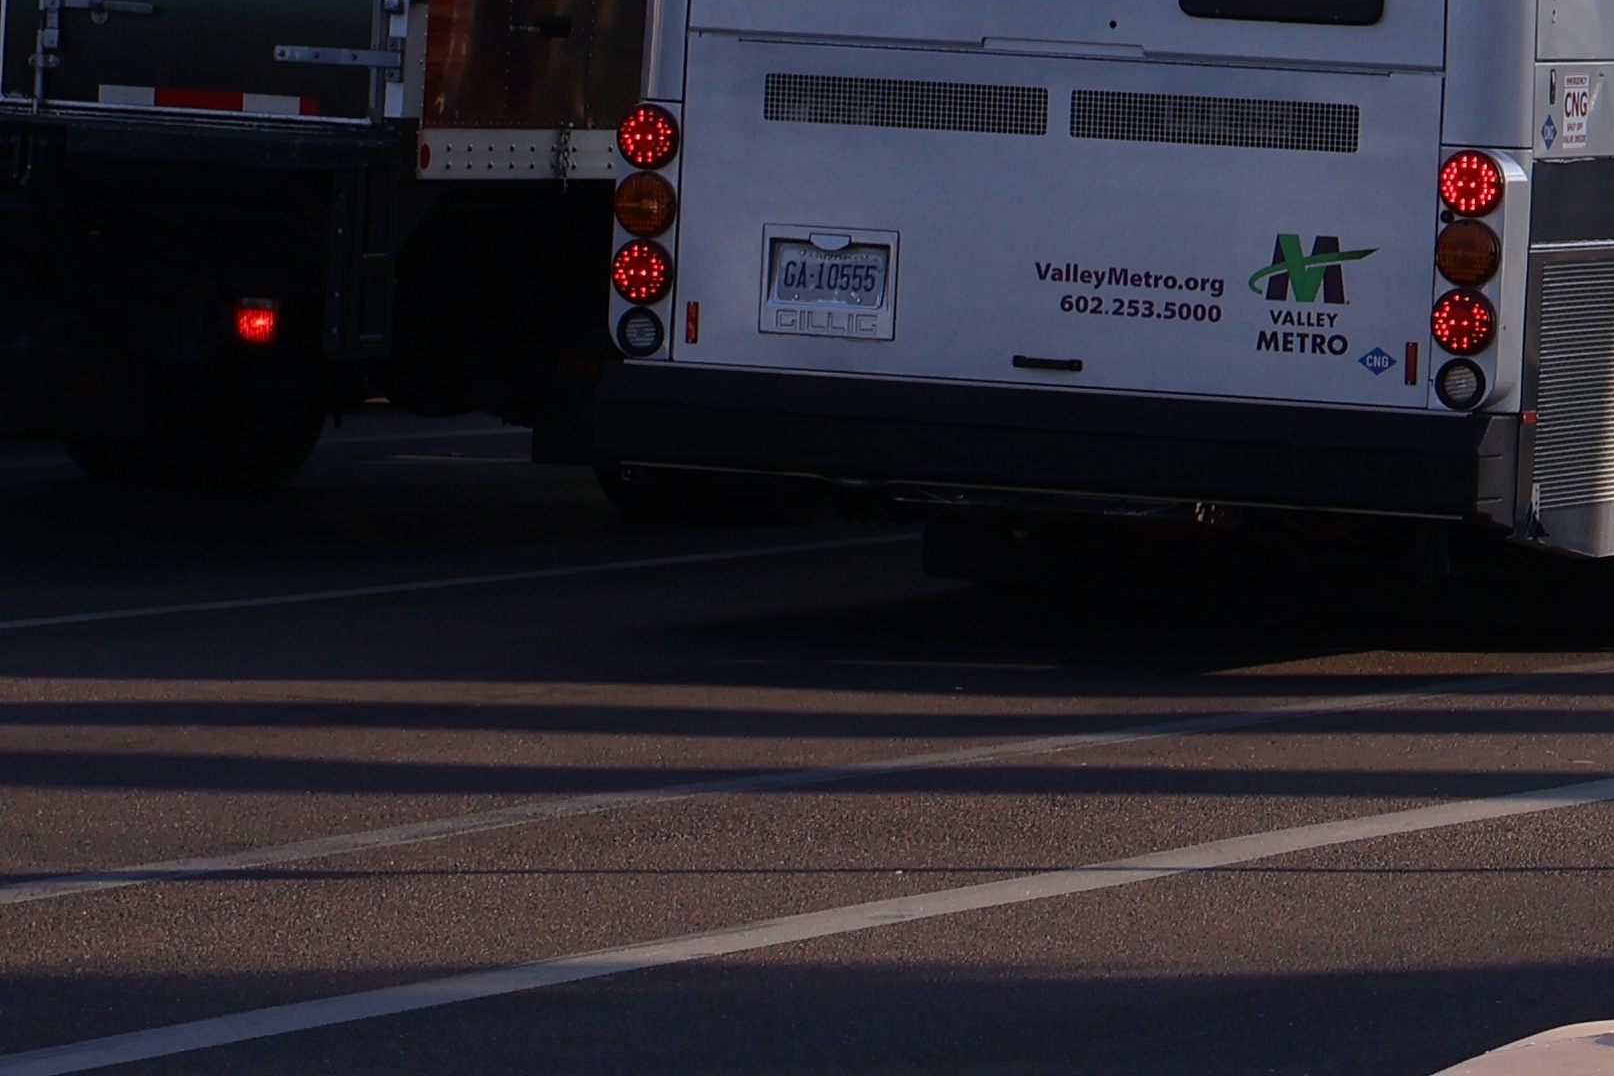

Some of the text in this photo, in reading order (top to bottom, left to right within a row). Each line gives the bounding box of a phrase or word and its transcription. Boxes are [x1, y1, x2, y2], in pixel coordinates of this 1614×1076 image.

[1564, 91, 1588, 117] CNG
[1035, 261, 1224, 297] ValleyMetro.org
[1060, 294, 1222, 323] 602.253.5000
[1270, 309, 1338, 328] VALLEY
[775, 308, 878, 336] GILLIG
[1256, 330, 1348, 355] METRO
[1366, 354, 1388, 368] CNG
